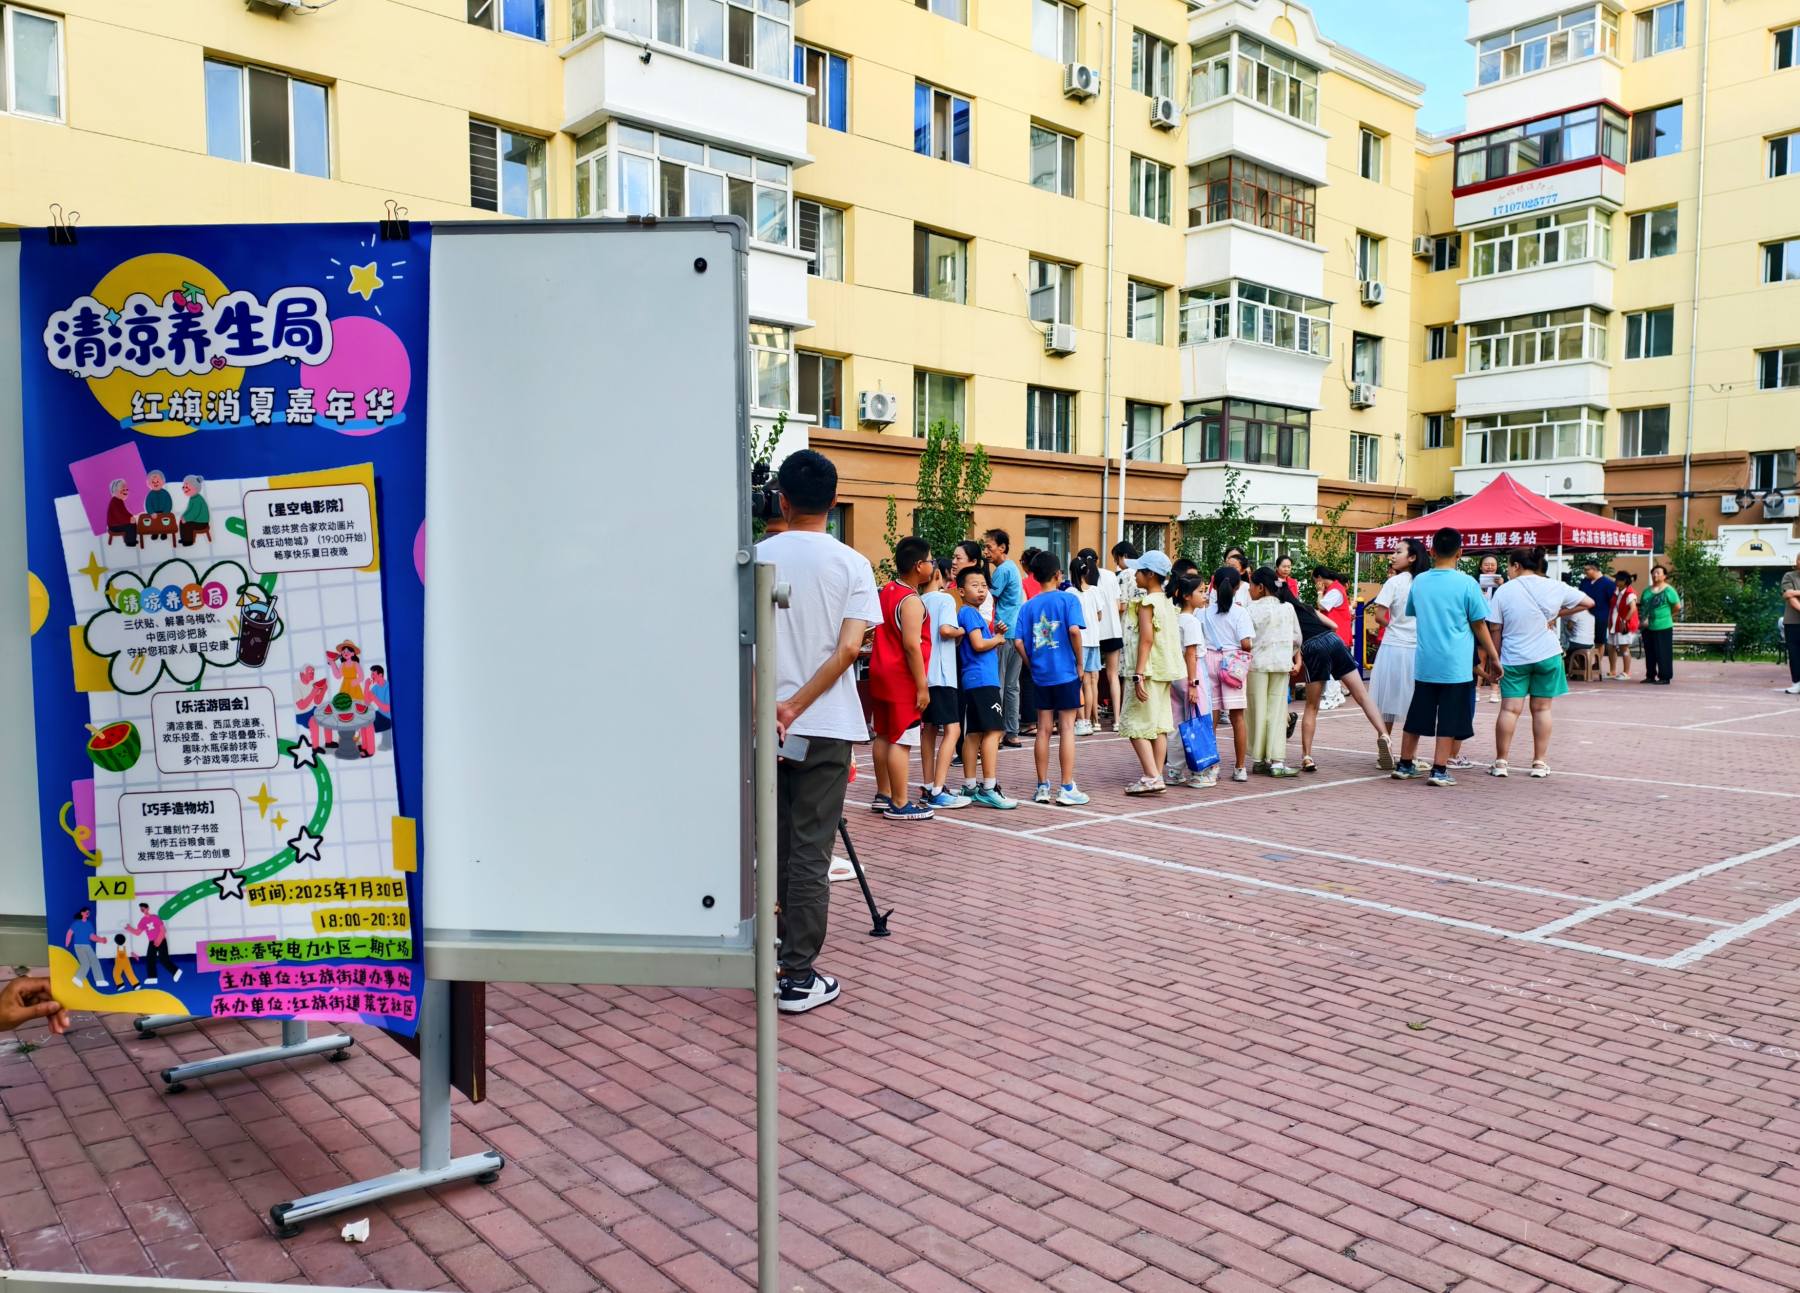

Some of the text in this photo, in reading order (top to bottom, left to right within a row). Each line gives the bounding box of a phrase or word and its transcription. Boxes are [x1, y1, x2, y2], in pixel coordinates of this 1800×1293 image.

[1493, 193, 1558, 215] 17107025777
[54, 297, 324, 368] 清凉养生局
[131, 386, 395, 425] 红旗消夏嘉年华
[268, 498, 344, 517] 【星空电影院】
[262, 520, 355, 535] 邀您共赏合家欢动画片
[274, 546, 348, 561] 畅享快乐夏日夜晚
[123, 587, 223, 611] 清凉养生局
[124, 615, 222, 631] 三伏贴、解暑乌梅饮、
[146, 628, 207, 643] 中医问诊把脉
[127, 640, 229, 658] 守护您和家人夏日安康
[175, 697, 249, 714] 【乐活游园会】
[182, 741, 258, 754] 趣味水瓶保龄球等
[184, 753, 259, 766] 多个游戏等您来玩
[142, 801, 215, 816] 【巧手造物坊】
[145, 823, 219, 836] 手工雕刻竹子书签
[151, 836, 215, 849] 制作五谷粮食画
[137, 848, 231, 862] 发挥您独一无二的创意
[94, 880, 127, 896] 入口
[320, 912, 406, 929] 18:00-20:30
